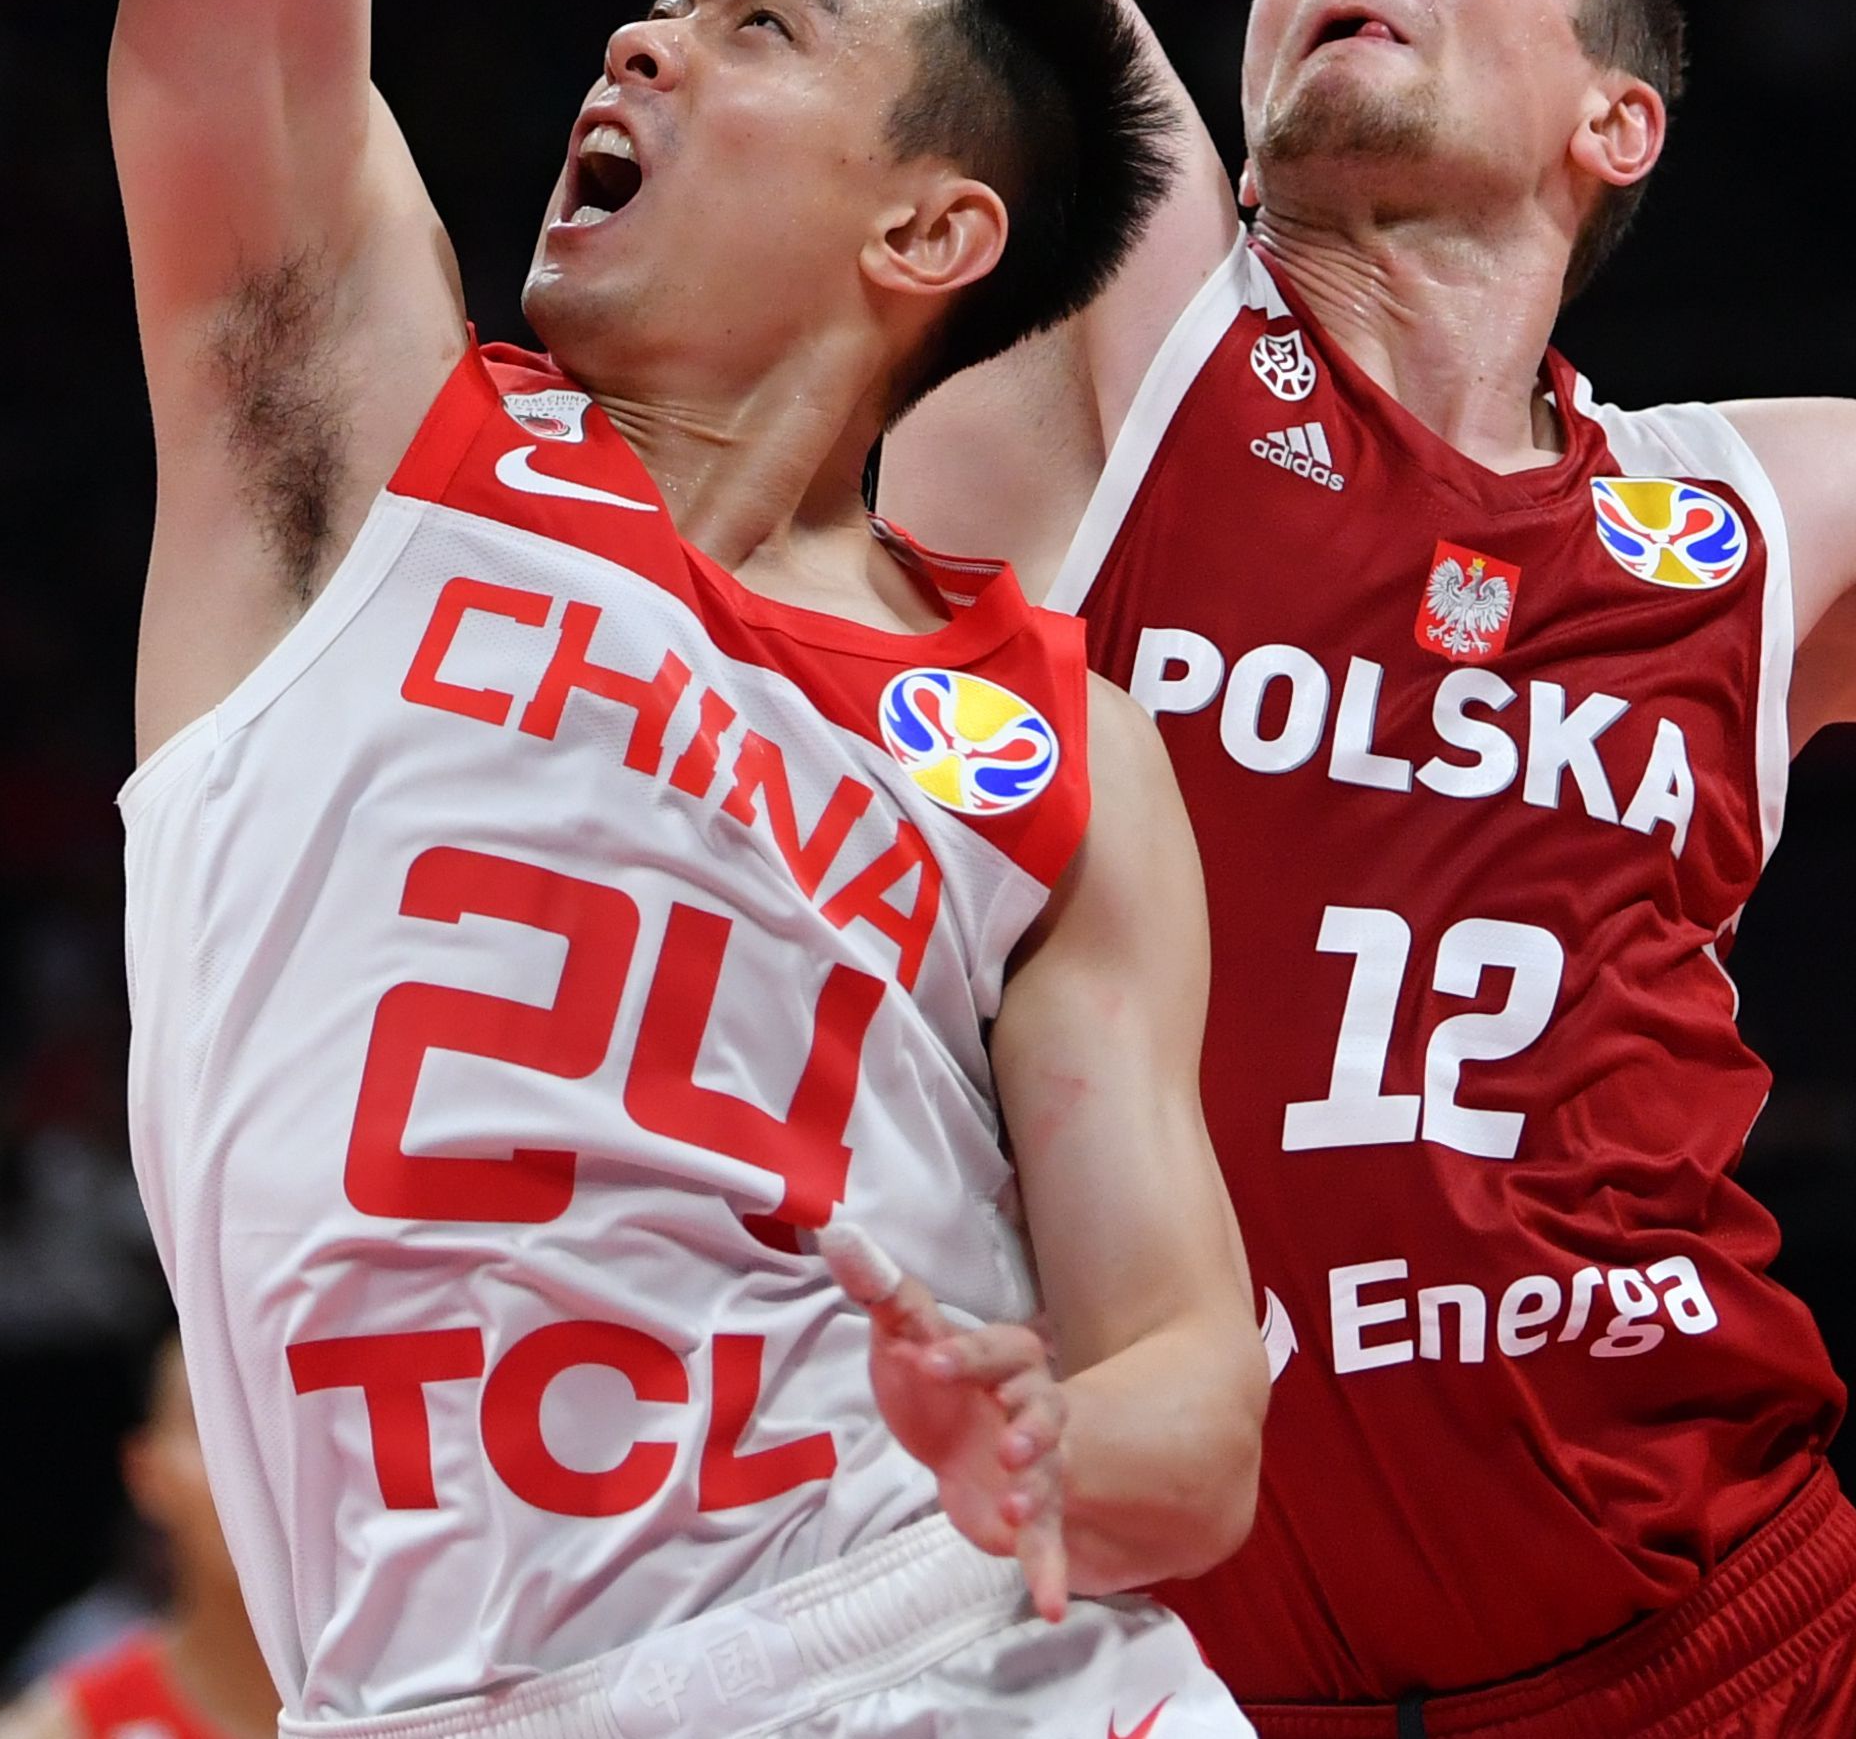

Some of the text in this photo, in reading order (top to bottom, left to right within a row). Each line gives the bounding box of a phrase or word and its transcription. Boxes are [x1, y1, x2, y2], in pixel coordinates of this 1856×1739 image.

[1250, 438, 1344, 492] adidas
[401, 578, 942, 988] CHINA
[1130, 628, 1695, 860] POLSKA
[344, 846, 887, 1232] 24
[1281, 905, 1564, 1159] 12
[286, 1320, 837, 1517] TCL
[1329, 1255, 1719, 1375] Energa
